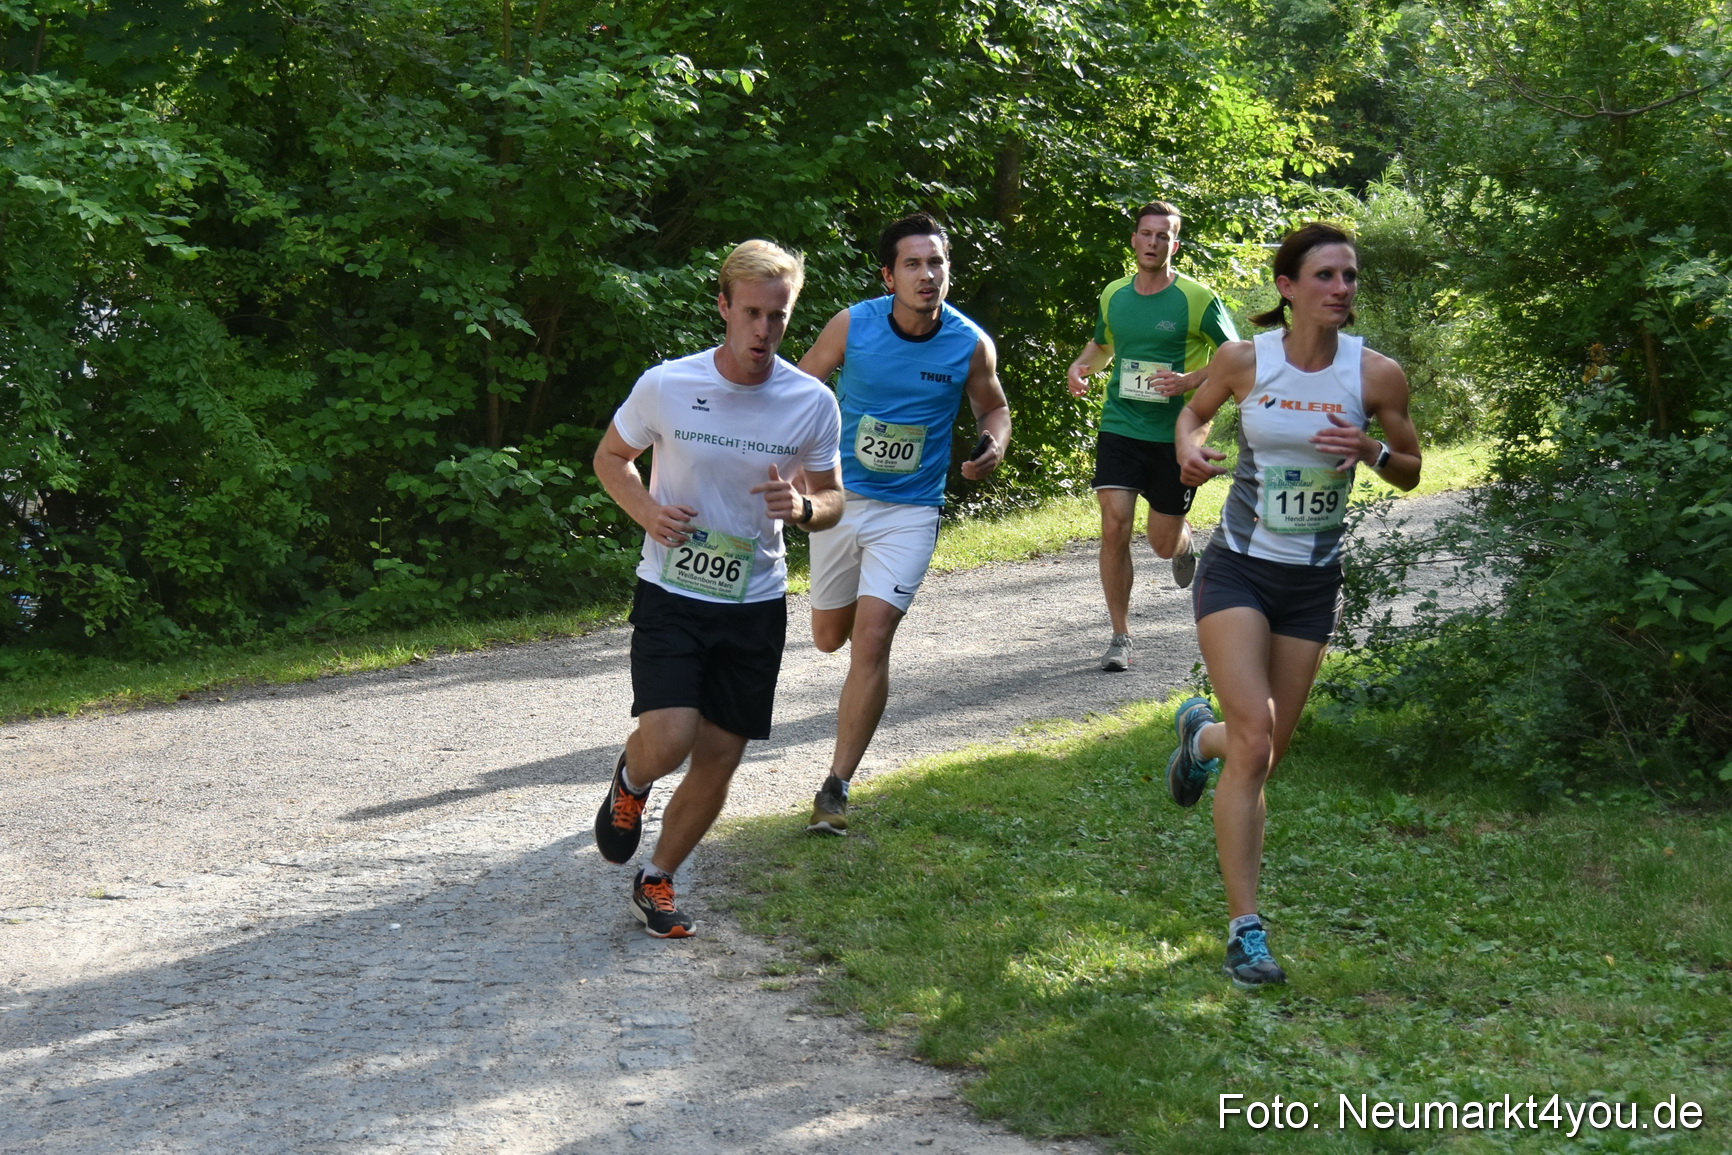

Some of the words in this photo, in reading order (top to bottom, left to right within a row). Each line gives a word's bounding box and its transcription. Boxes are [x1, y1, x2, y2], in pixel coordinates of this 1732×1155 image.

[920, 371, 953, 384] THULE
[1280, 399, 1347, 414] KLEBL
[674, 429, 741, 448] RUPPRECHT
[747, 440, 799, 456] HOLZBAU
[861, 436, 914, 460] 2300
[1183, 488, 1191, 510] 9
[1275, 490, 1339, 515] 1159
[675, 546, 742, 583] 2096
[678, 570, 717, 586] Weißenborn
[718, 580, 734, 590] Marc
